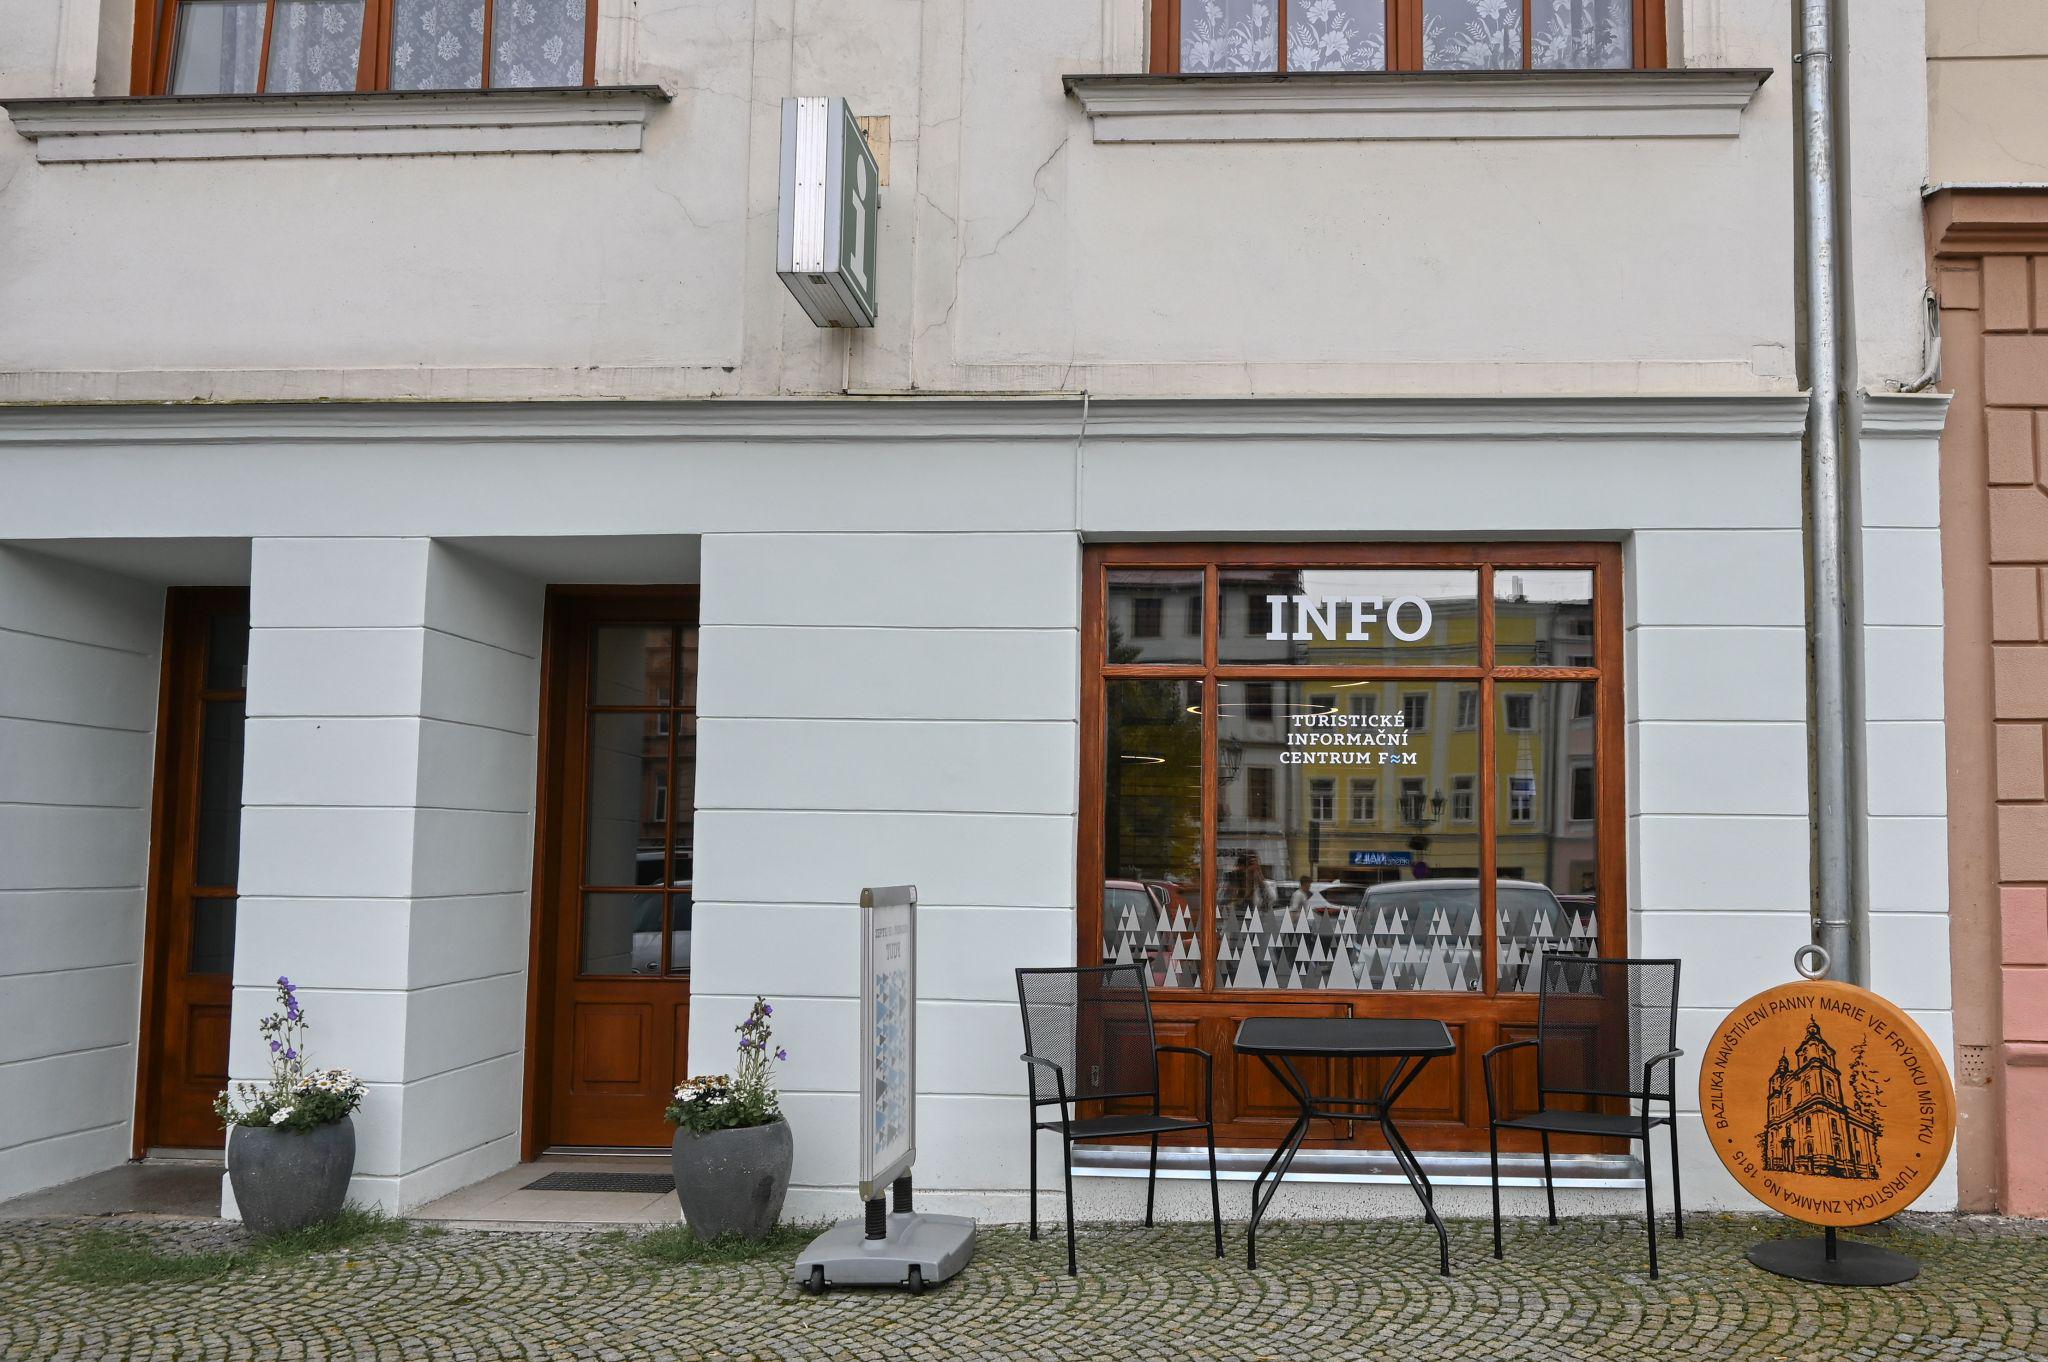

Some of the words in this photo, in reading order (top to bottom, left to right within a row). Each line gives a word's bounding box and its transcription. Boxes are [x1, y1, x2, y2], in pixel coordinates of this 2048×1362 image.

[851, 154, 867, 292] i
[1266, 594, 1432, 642] INFO
[1291, 710, 1405, 727] TURISTICKÉ
[1287, 729, 1409, 746] INFORMAČNÍ
[1279, 751, 1371, 765] CENTRUM
[1770, 996, 1816, 1015] PANNY
[1820, 997, 1866, 1022] MARIE
[1715, 1003, 1771, 1070] NAVŠTÍVENÍ
[1868, 1014, 1888, 1036] VE
[1885, 1031, 1928, 1087] FRÝDKU
[1710, 1071, 1729, 1129] BAZILIKA
[1919, 1090, 1938, 1144] MÍSTKU
[1732, 1150, 1759, 1179] 1815
[1783, 1188, 1842, 1214] ZNÁMKA
[1843, 1164, 1919, 1215] TURISTICKÁ
